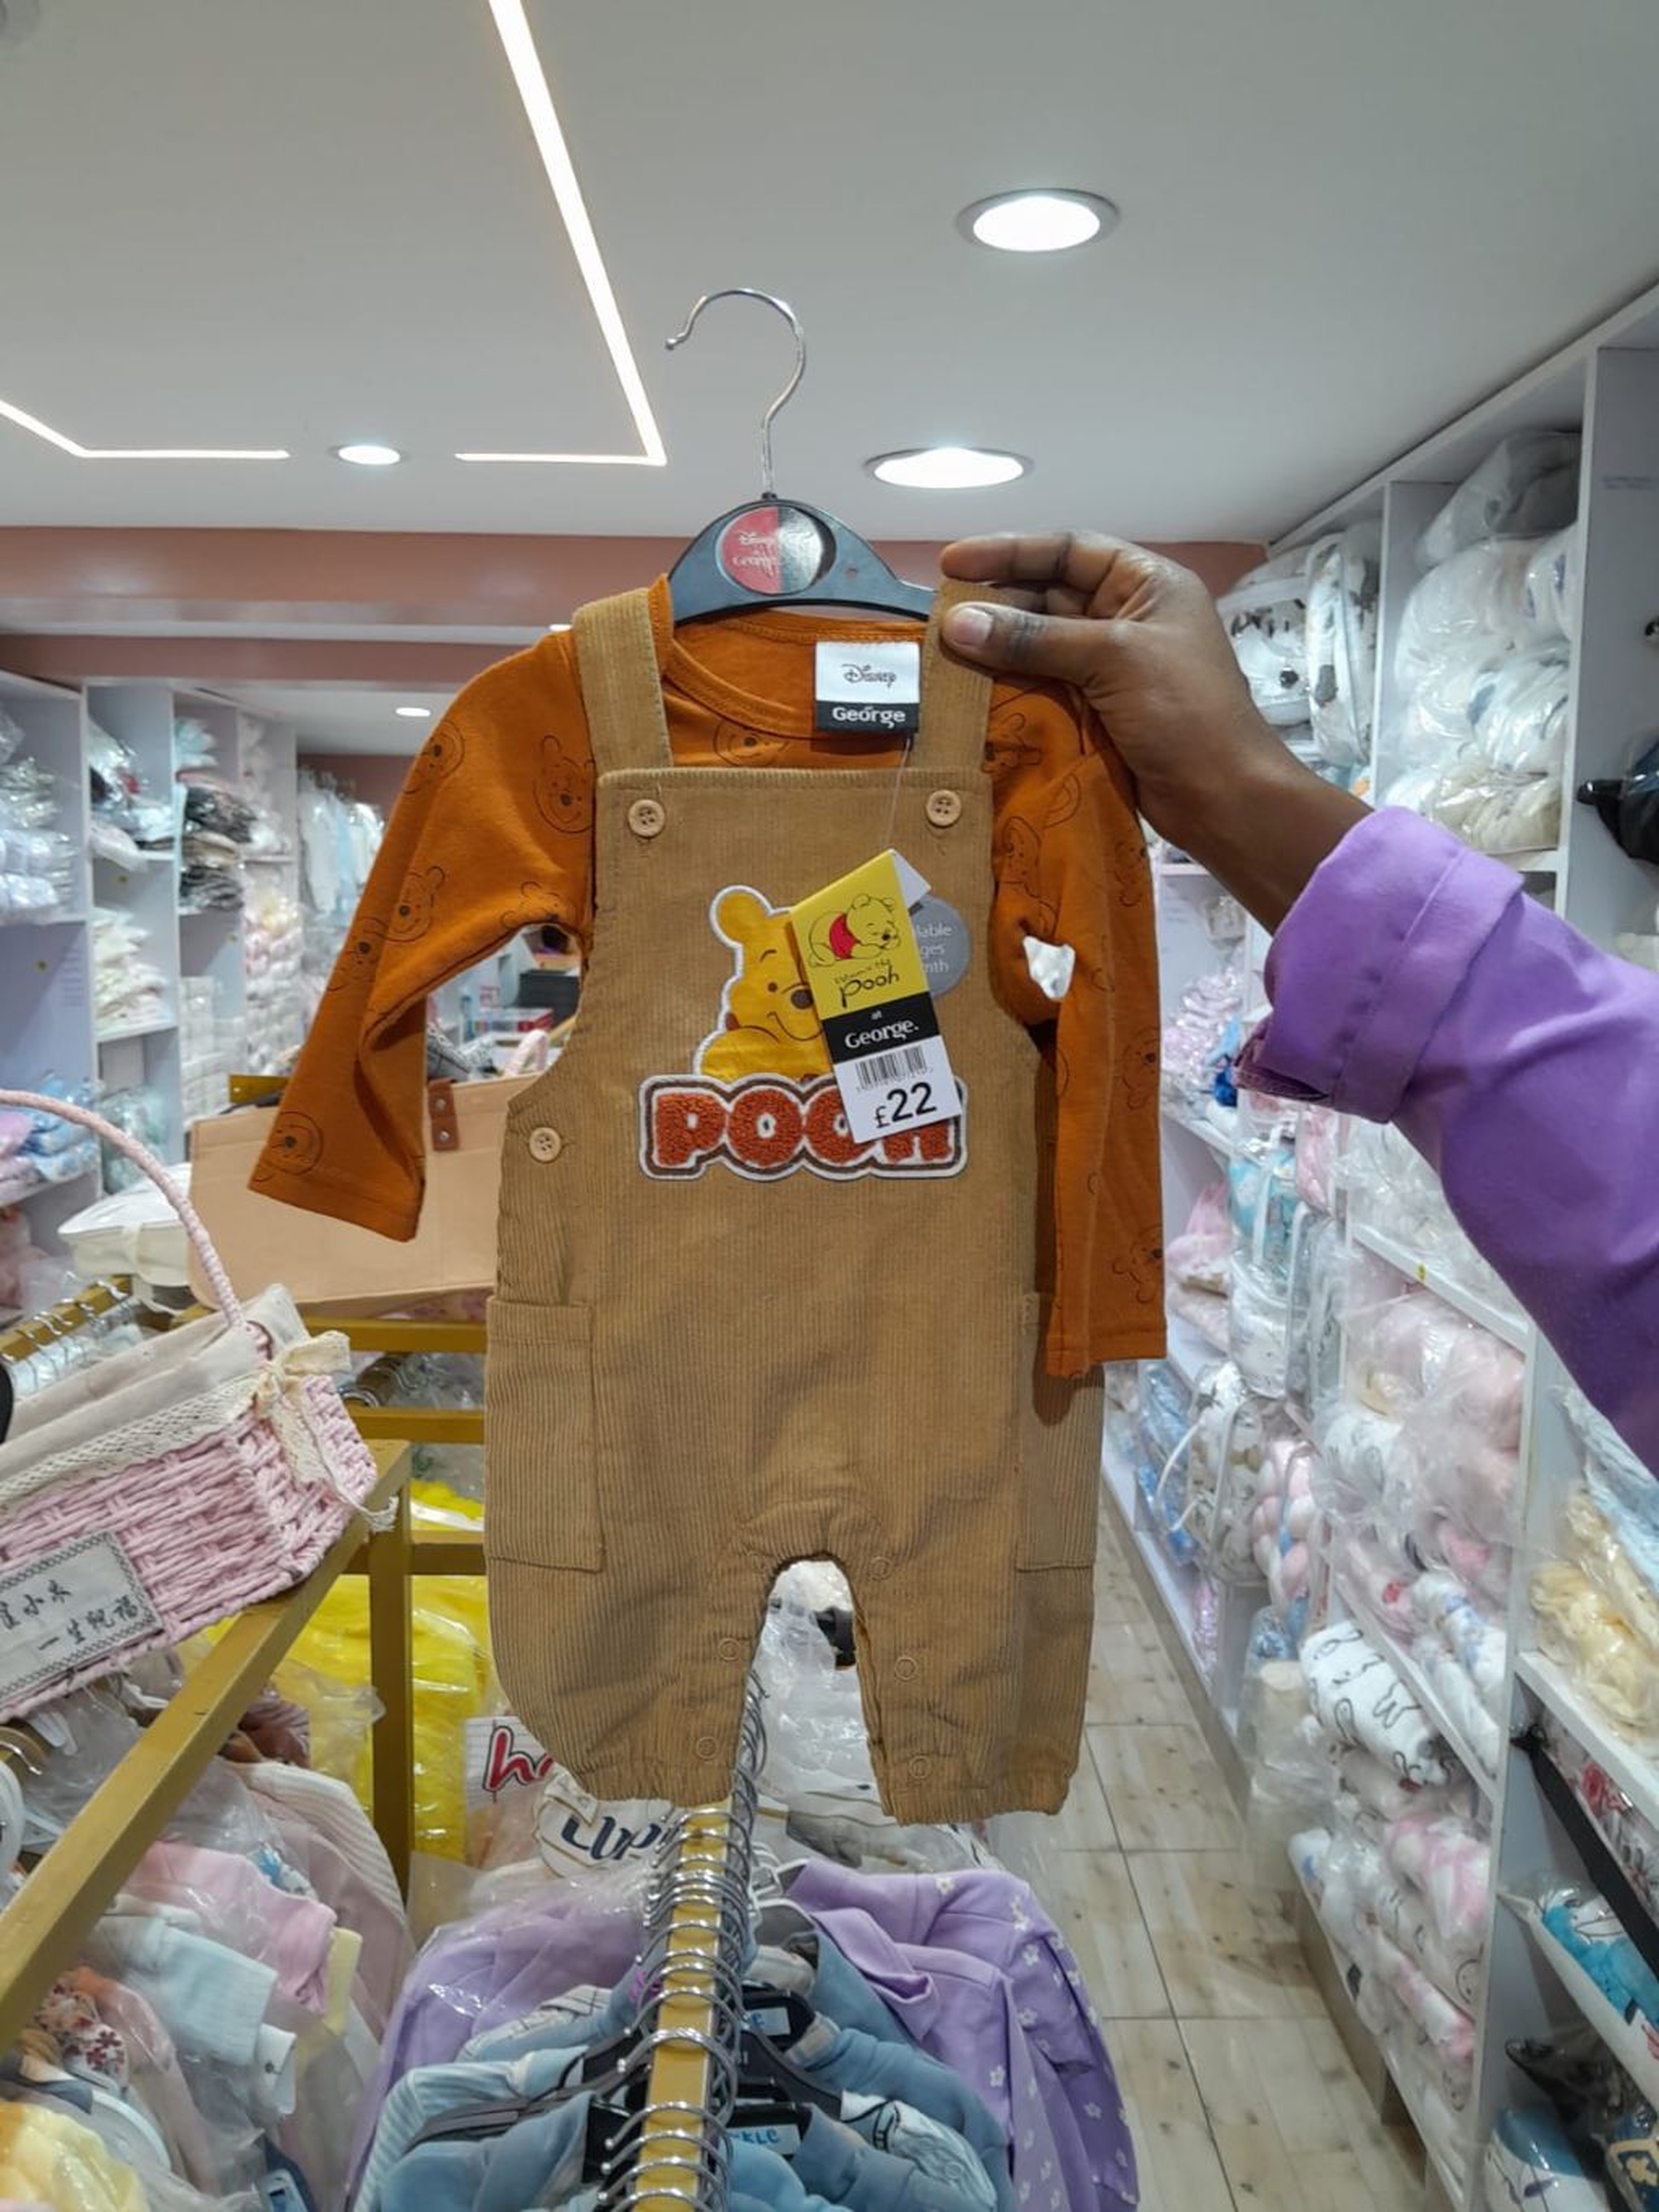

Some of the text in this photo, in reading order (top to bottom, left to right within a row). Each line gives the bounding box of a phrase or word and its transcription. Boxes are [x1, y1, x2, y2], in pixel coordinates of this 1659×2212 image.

[841, 663, 897, 688] Disney
[832, 706, 907, 729] George
[876, 1082, 938, 1128] £22
